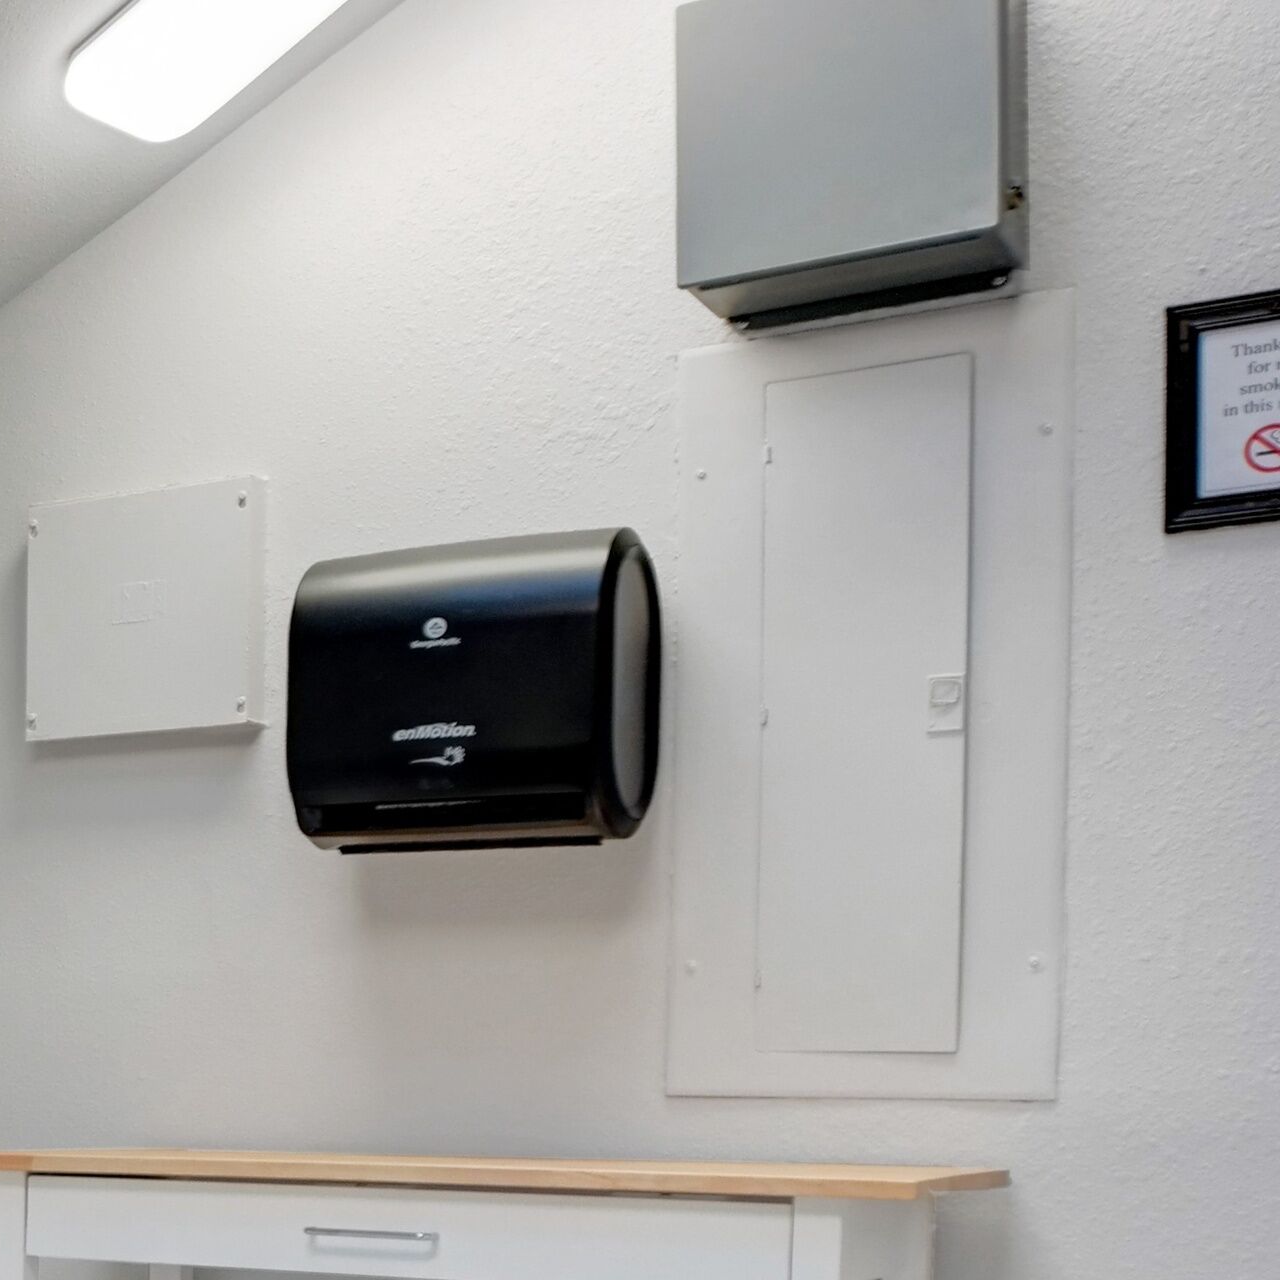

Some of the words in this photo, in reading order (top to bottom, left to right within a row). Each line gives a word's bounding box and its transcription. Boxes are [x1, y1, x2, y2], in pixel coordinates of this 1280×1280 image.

[1248, 361, 1272, 374] for
[1223, 404, 1239, 417] in
[1244, 399, 1273, 414] this
[392, 721, 478, 741] enMotion
